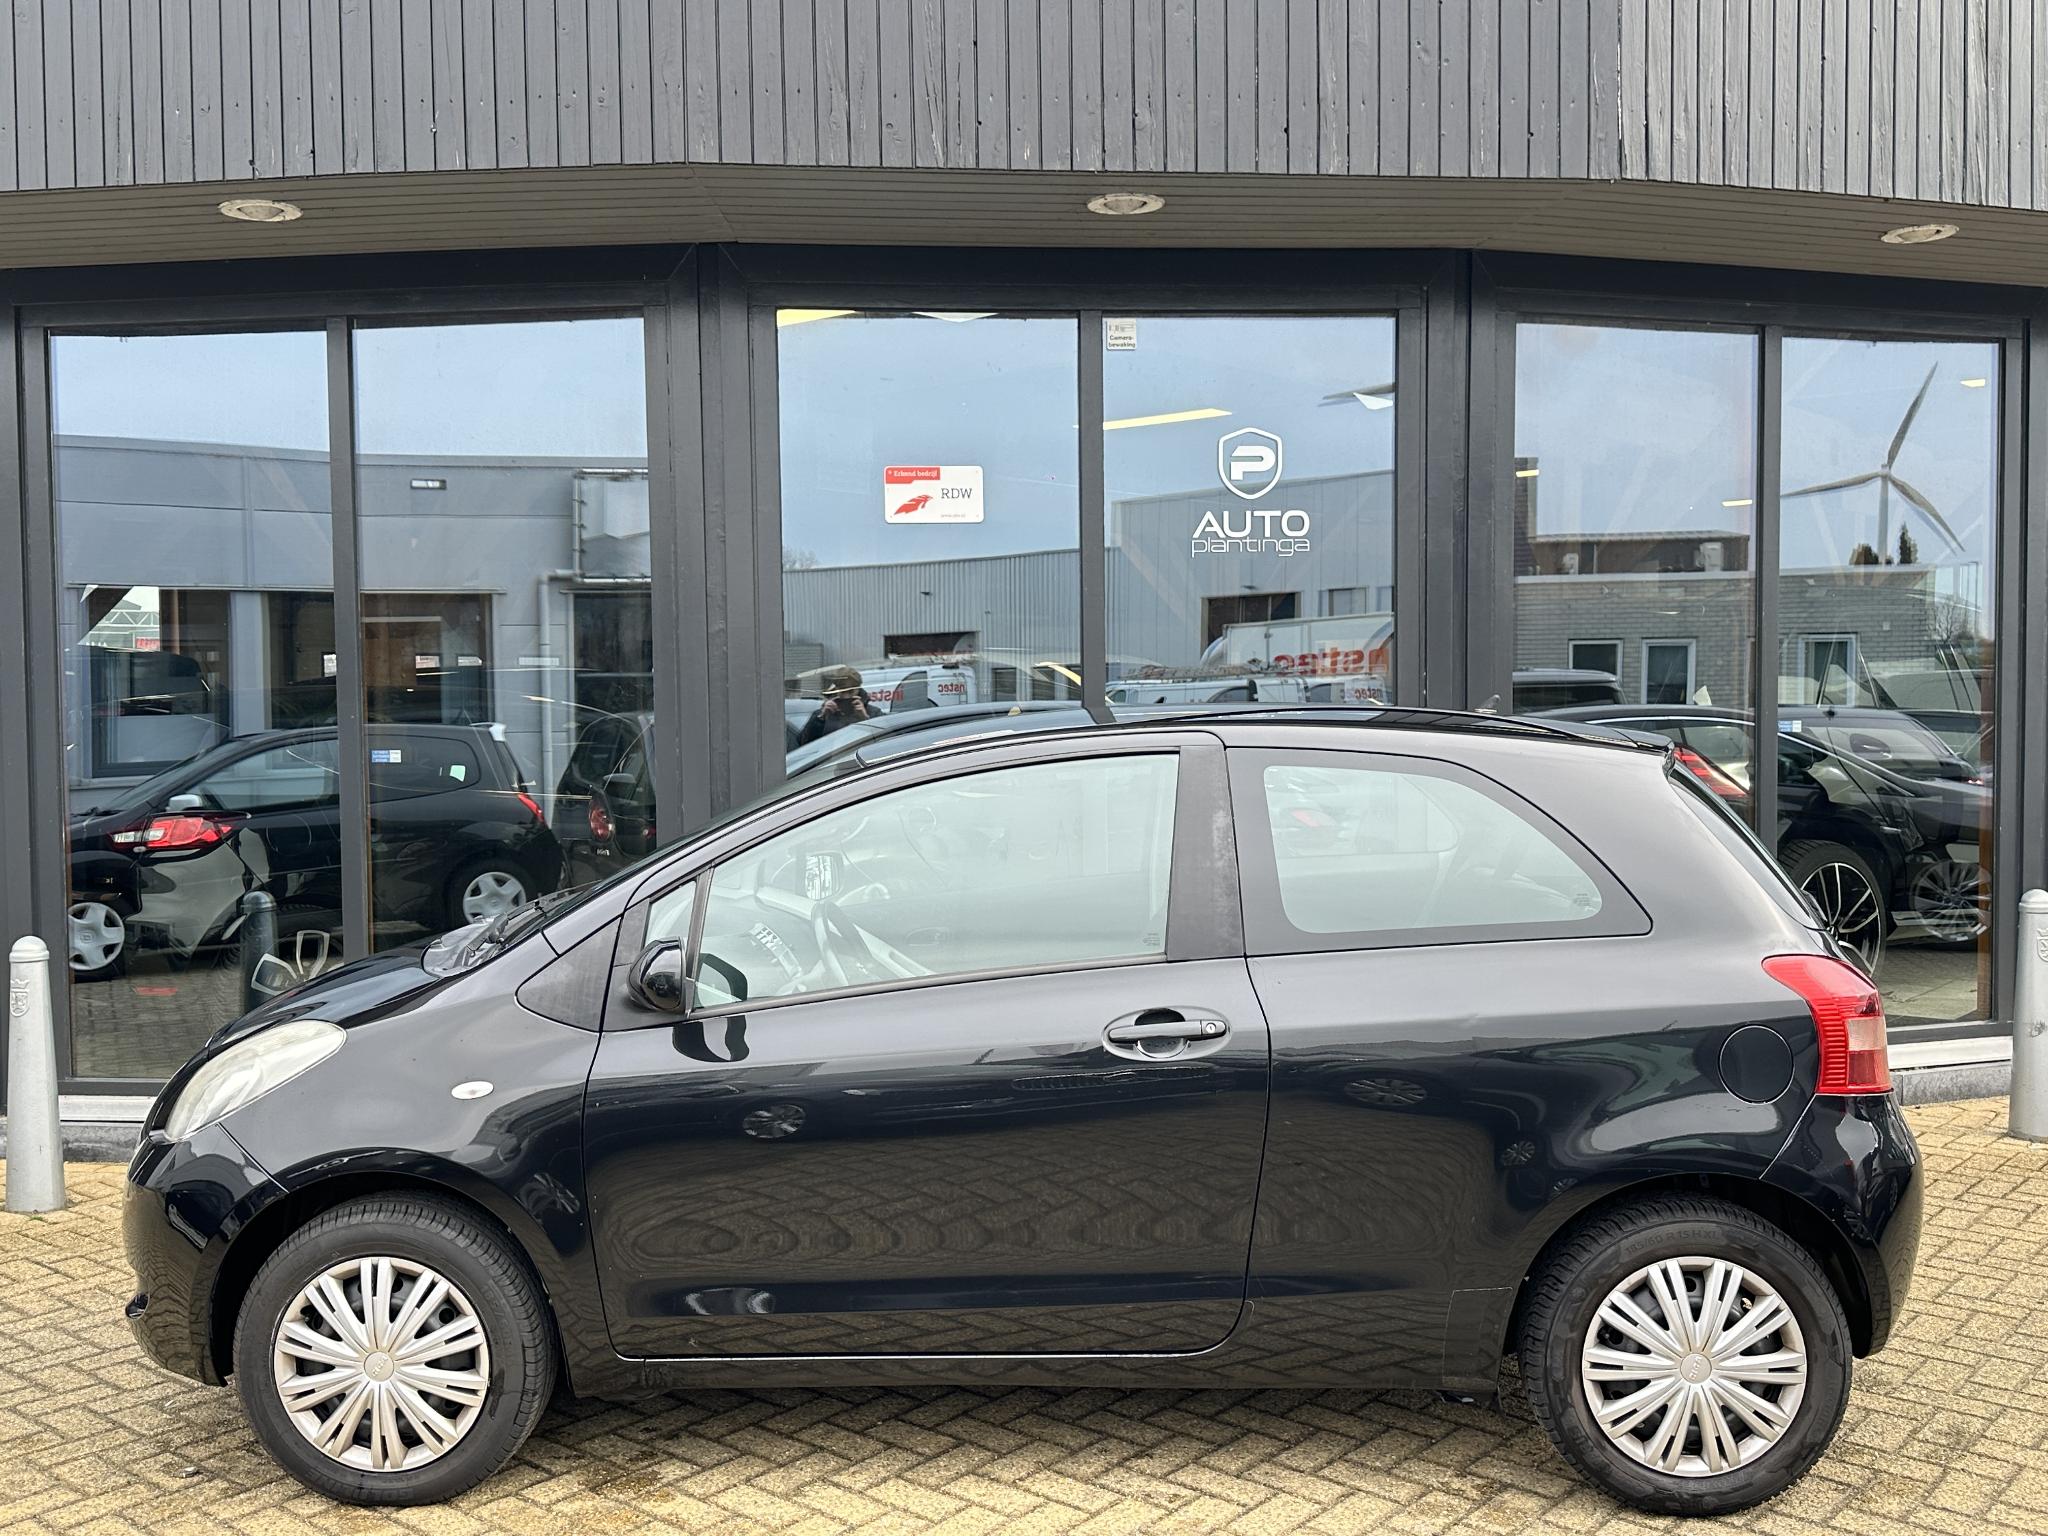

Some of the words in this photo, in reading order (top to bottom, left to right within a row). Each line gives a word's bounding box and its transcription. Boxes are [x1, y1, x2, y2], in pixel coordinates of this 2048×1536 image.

[1230, 445, 1276, 480] P
[940, 487, 973, 499] RDW
[1191, 510, 1310, 538] AUTO
[1191, 536, 1310, 558] plantinga
